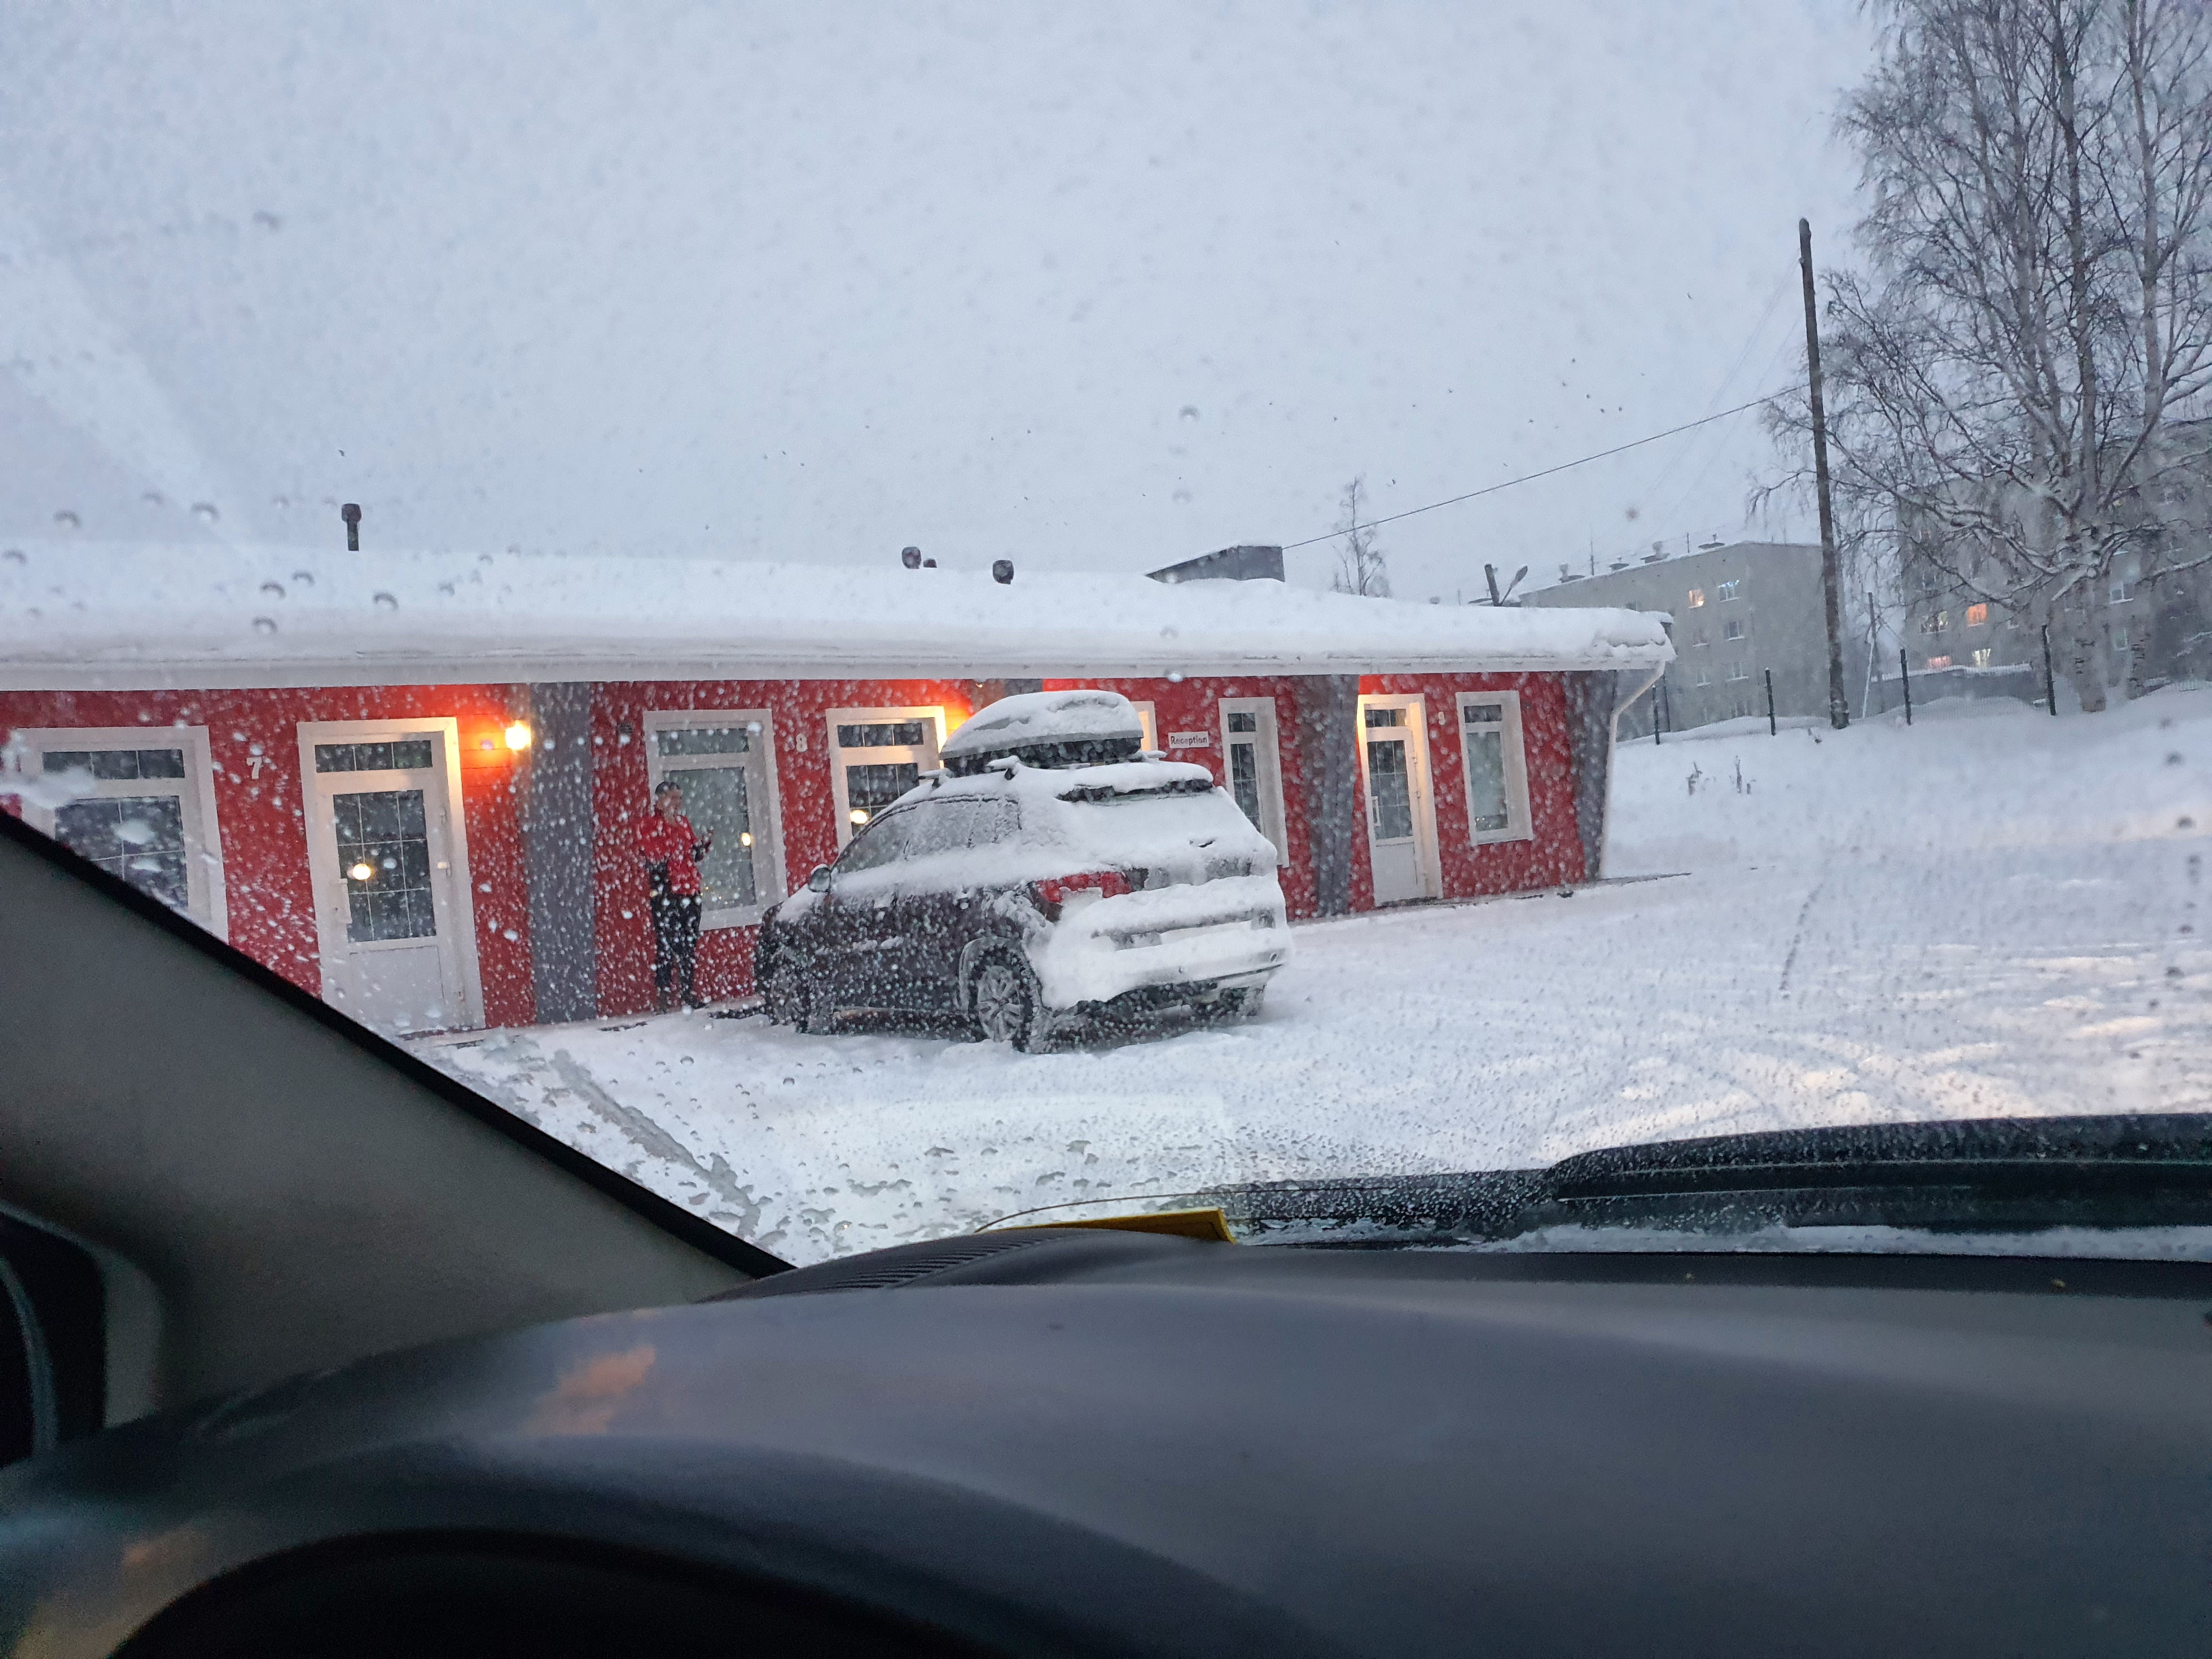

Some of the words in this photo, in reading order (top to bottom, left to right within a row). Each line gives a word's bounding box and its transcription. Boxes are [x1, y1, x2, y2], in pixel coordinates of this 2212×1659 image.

[796, 733, 808, 752] 8
[1170, 735, 1207, 746] Reception
[246, 757, 263, 779] 7
